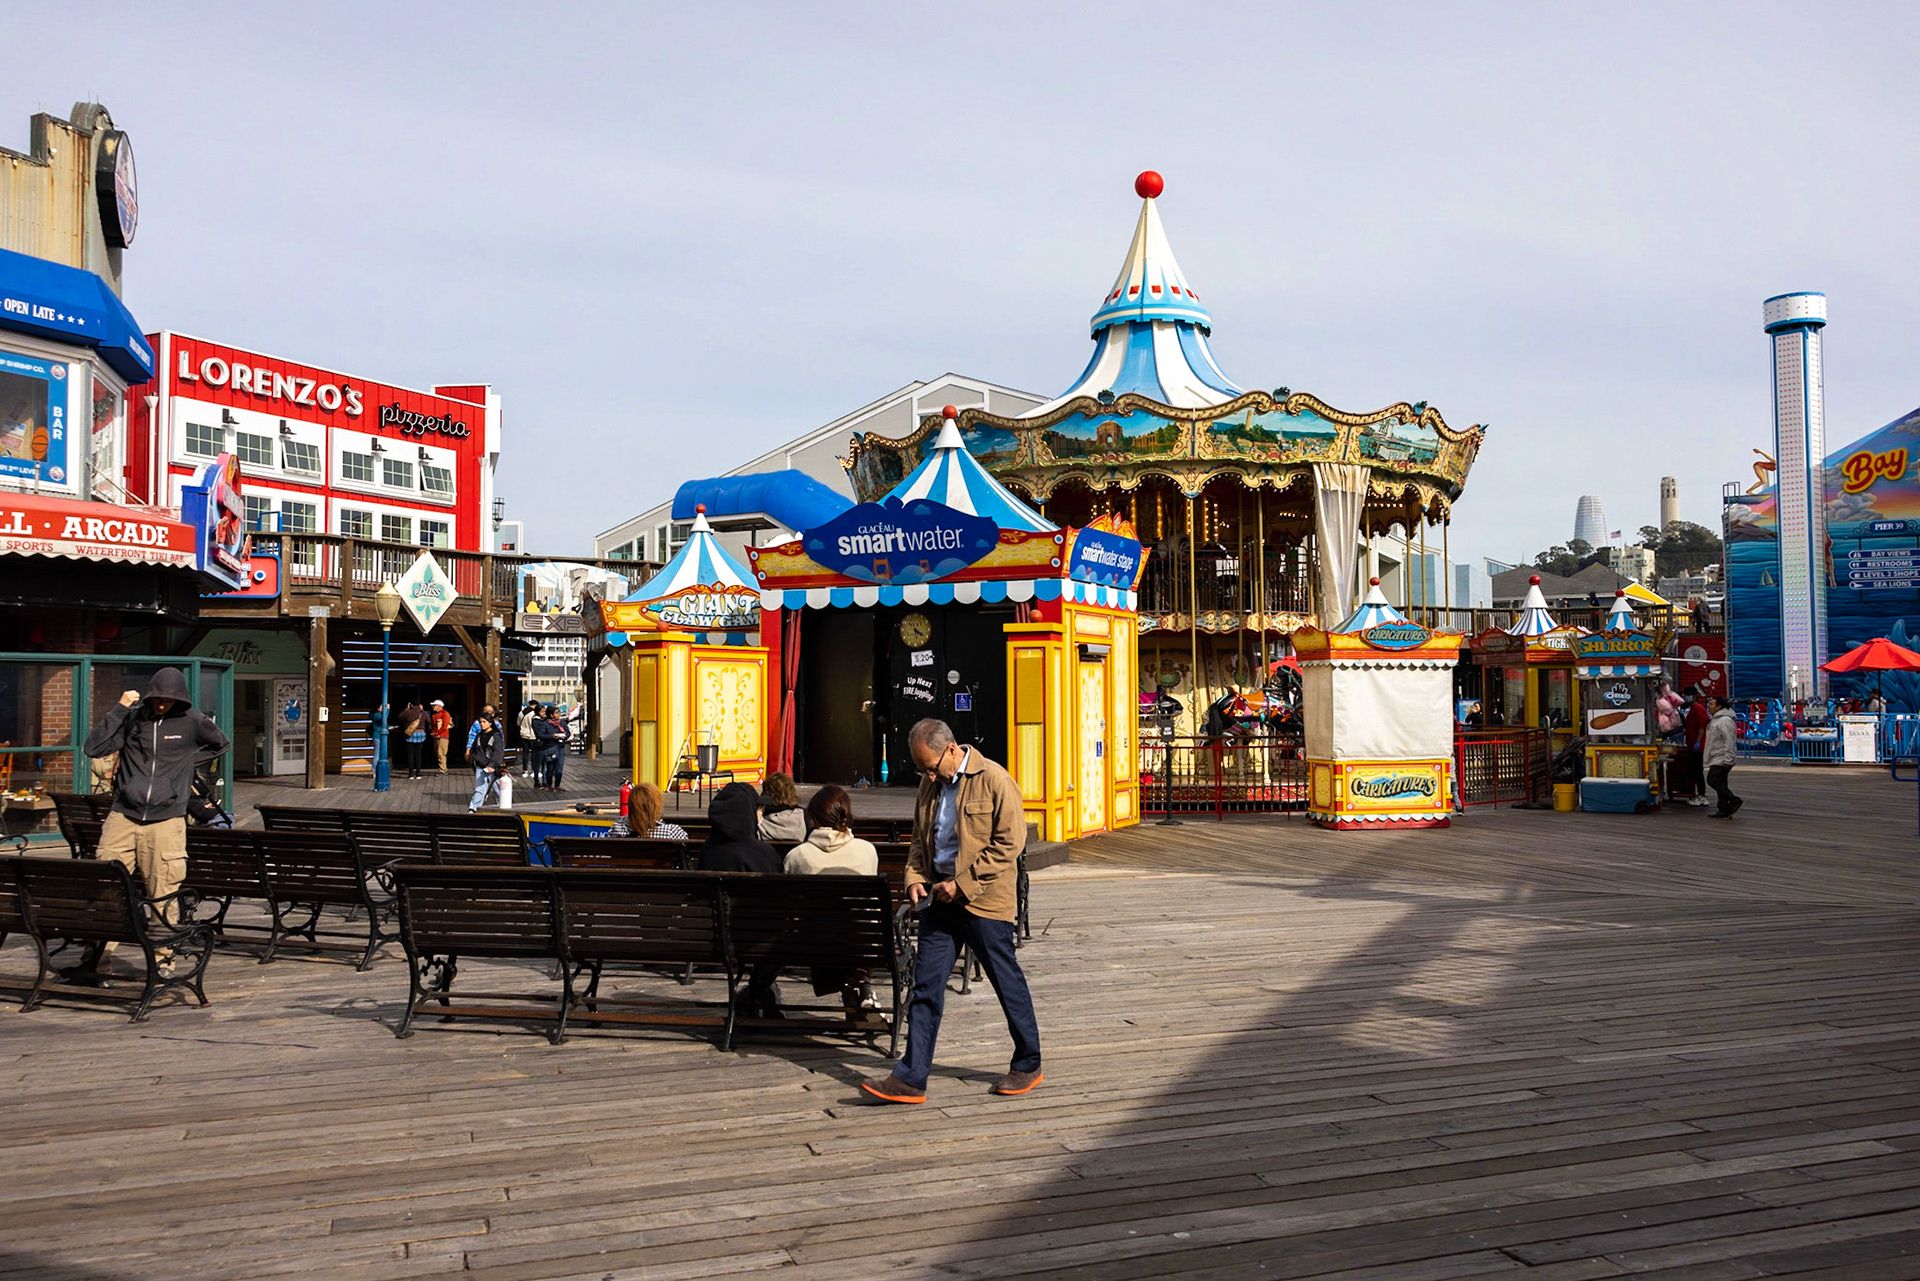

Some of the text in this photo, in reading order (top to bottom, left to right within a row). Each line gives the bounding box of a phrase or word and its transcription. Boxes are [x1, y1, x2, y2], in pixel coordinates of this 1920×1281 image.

[4, 298, 56, 321] OPEN LATE
[179, 350, 364, 415] LORENZO'S
[52, 406, 64, 440] BAR
[379, 402, 472, 438] pizzeria
[19, 467, 36, 475] LEVE
[1841, 447, 1908, 493] Bay
[61, 516, 169, 547] ARCADE
[858, 522, 895, 534] GLACÉAU
[1874, 522, 1904, 531] PIER 39
[837, 525, 964, 556] smartwater
[6, 540, 54, 552] SPORTS
[75, 545, 147, 560] WATERFRONT
[150, 553, 168, 561] TIKI
[1867, 560, 1913, 568] RESTROOMS
[1863, 568, 1919, 578] LEVEL 2 SHOPS
[413, 582, 442, 598] Bliss
[1873, 580, 1912, 588] SEA LIONS
[679, 593, 757, 616] GIANT
[521, 615, 586, 631] EXP
[659, 610, 760, 627] CLAW GAM
[1365, 628, 1431, 642] CARICATURES
[1580, 640, 1655, 653] CHURROS
[907, 677, 933, 688] Up Next
[1351, 777, 1437, 798] CARICATURES
[589, 830, 609, 839] GLAC
